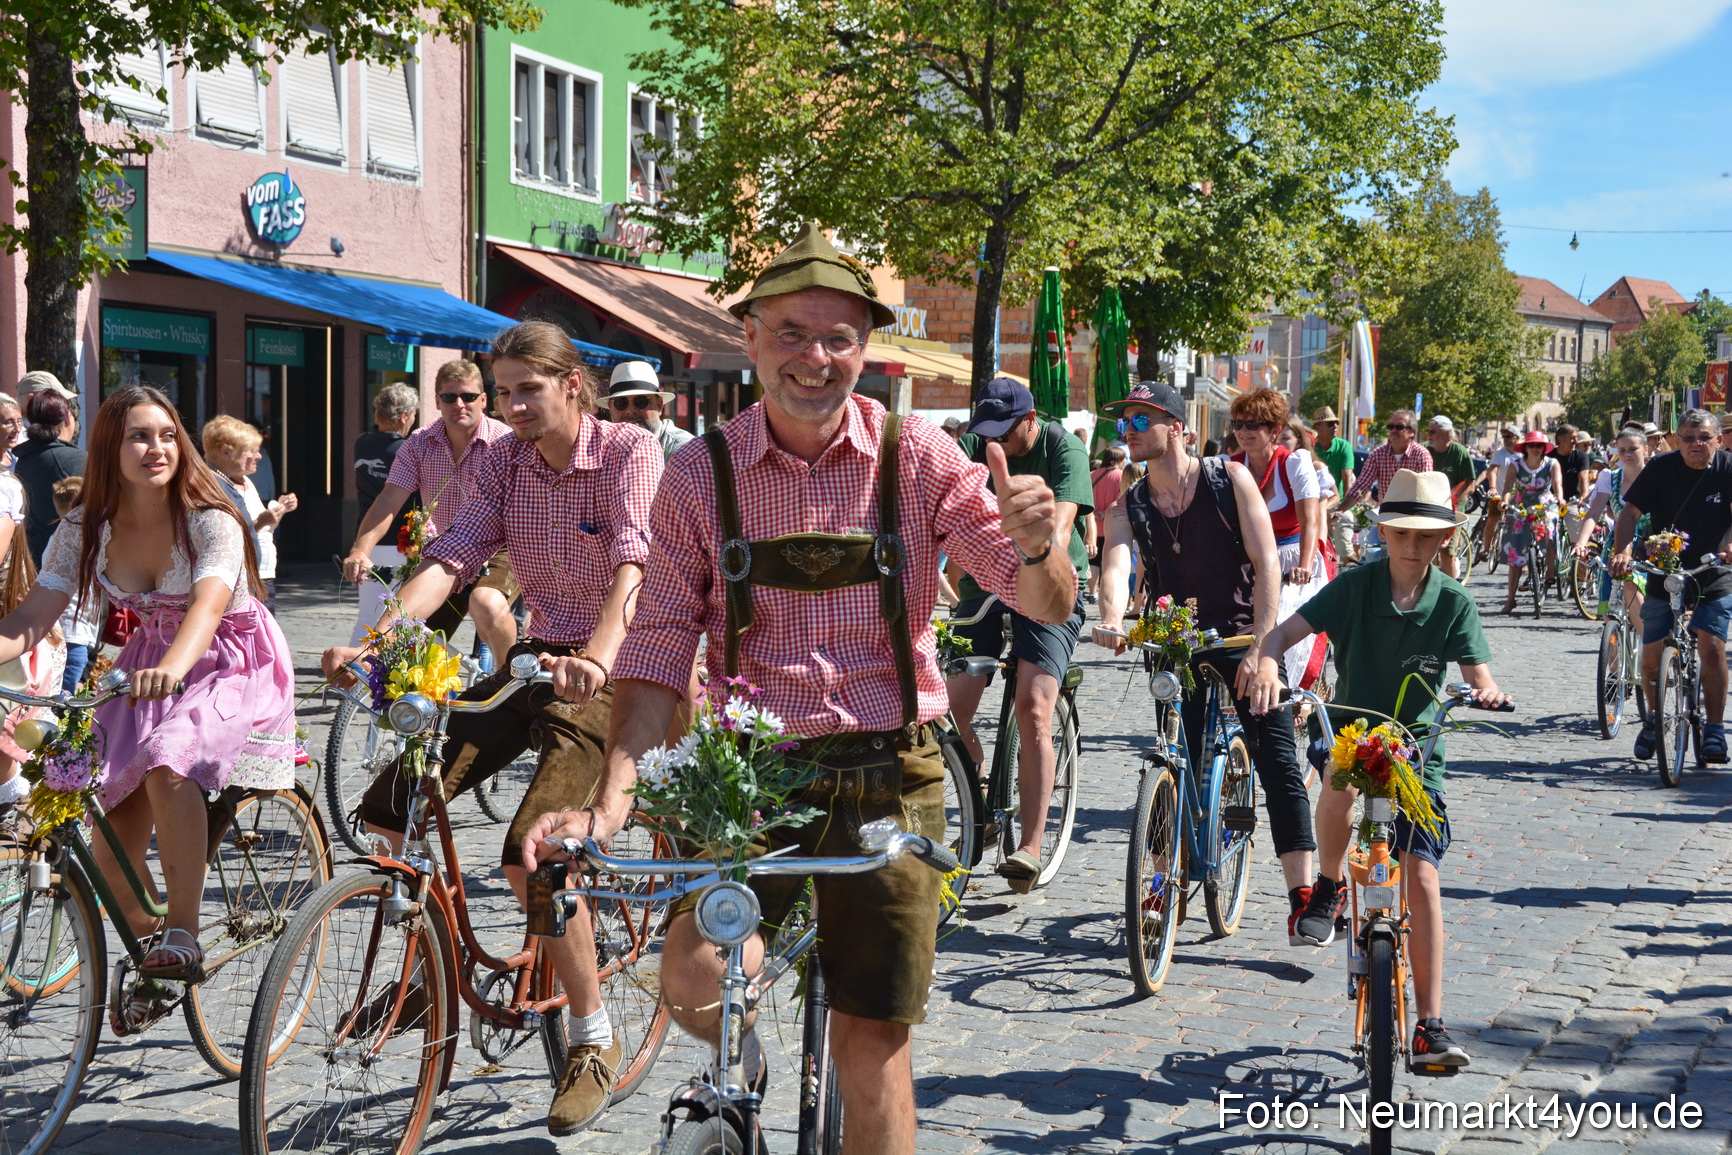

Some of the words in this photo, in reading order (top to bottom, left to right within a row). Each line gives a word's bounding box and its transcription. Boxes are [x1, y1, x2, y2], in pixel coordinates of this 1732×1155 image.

[247, 179, 279, 207] vom
[258, 196, 305, 236] FASS
[103, 318, 161, 340] Spirituosen
[169, 324, 208, 349] Whisky
[259, 338, 297, 356] Feinkost
[370, 345, 392, 364] Essig
